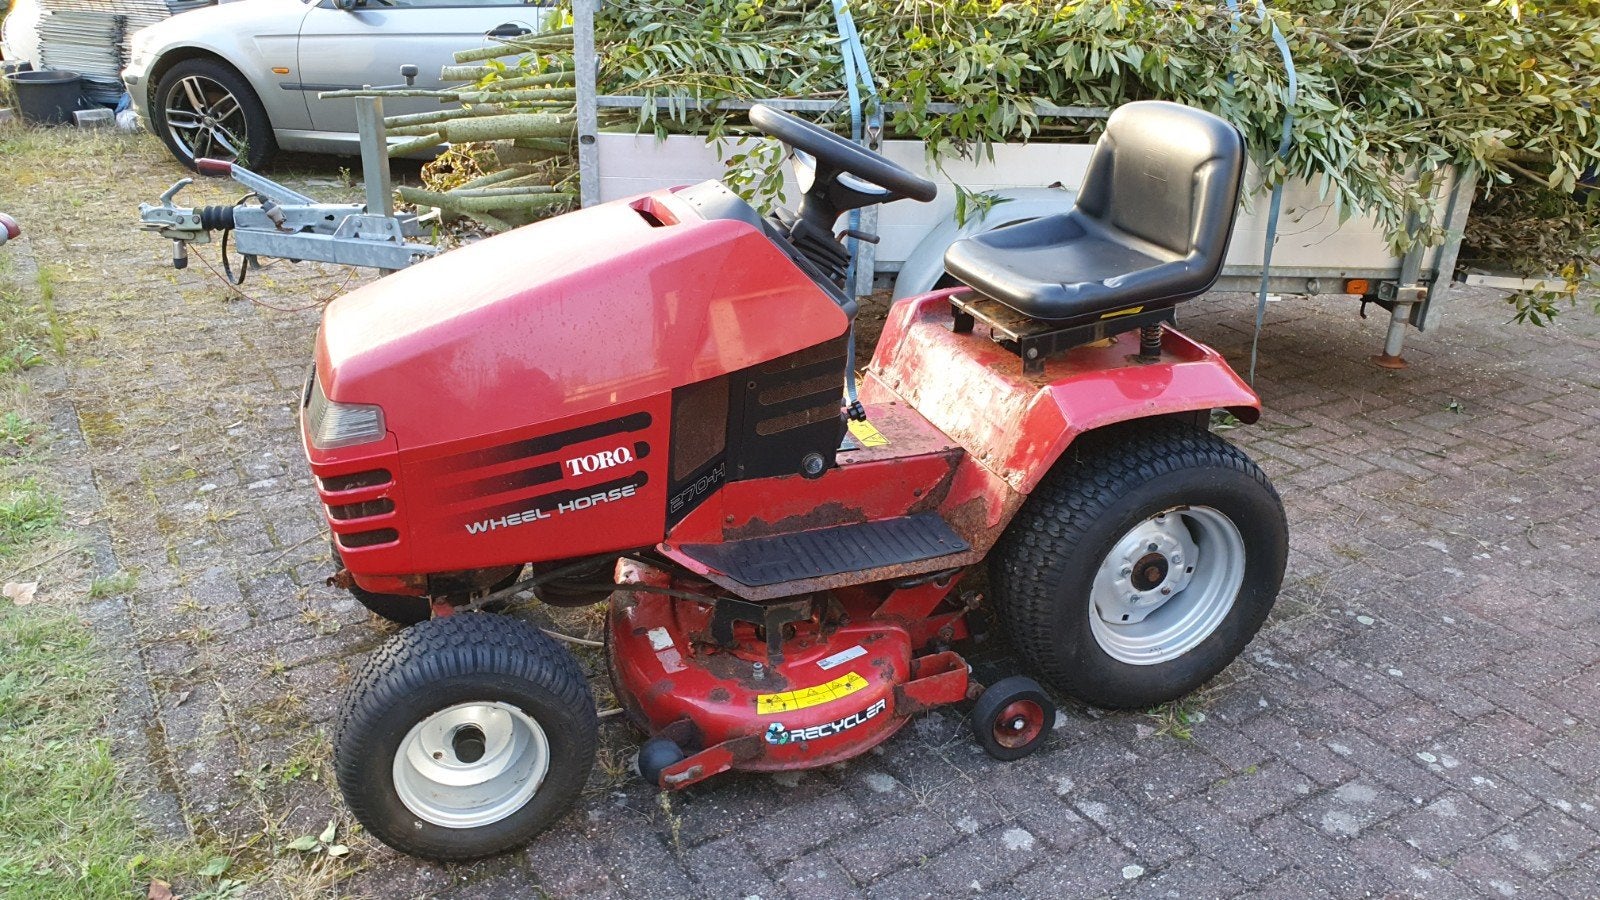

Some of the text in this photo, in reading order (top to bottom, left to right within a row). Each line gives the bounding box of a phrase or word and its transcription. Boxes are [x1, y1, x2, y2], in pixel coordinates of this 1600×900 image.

[465, 484, 636, 535] WHEEL HORSE
[670, 462, 726, 513] 270-H
[790, 698, 886, 743] RECYCLER
